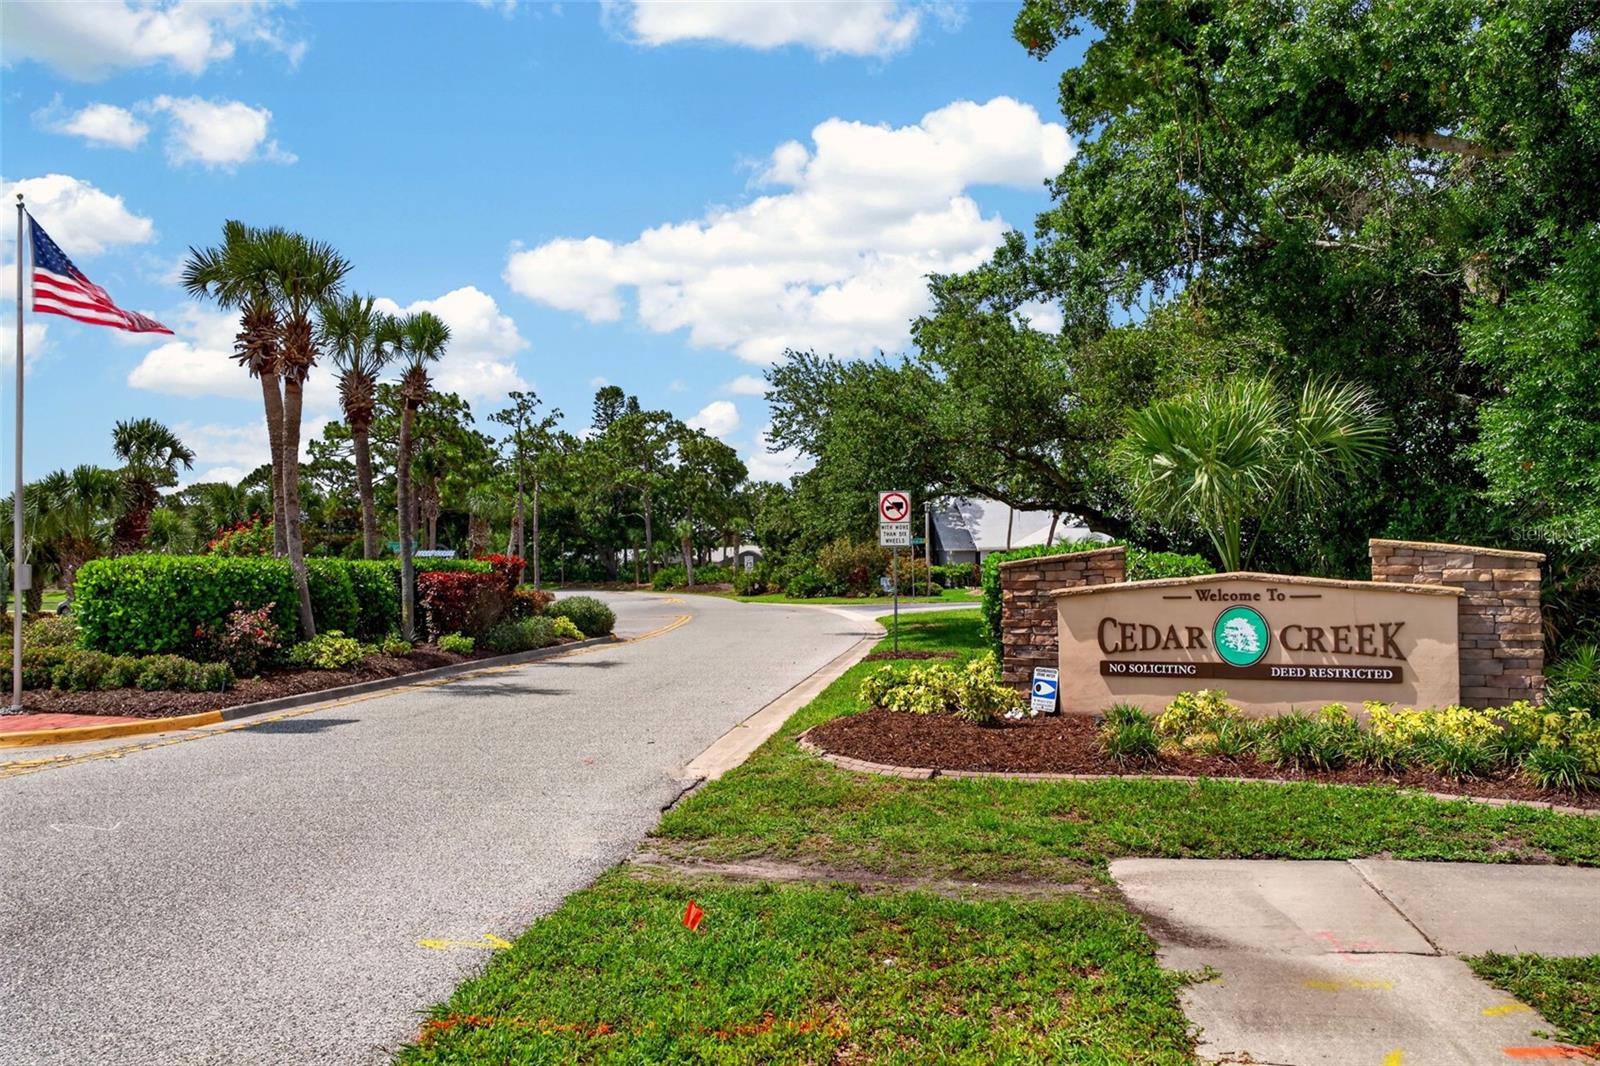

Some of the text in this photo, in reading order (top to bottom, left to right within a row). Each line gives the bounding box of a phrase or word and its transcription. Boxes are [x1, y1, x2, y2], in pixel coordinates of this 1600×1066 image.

[1195, 588, 1286, 602] Welcome To
[1097, 617, 1408, 662] CEDAR CREEK
[1109, 663, 1197, 675] NO SOLICITING
[1271, 667, 1393, 680] DEED RESTRICTED
